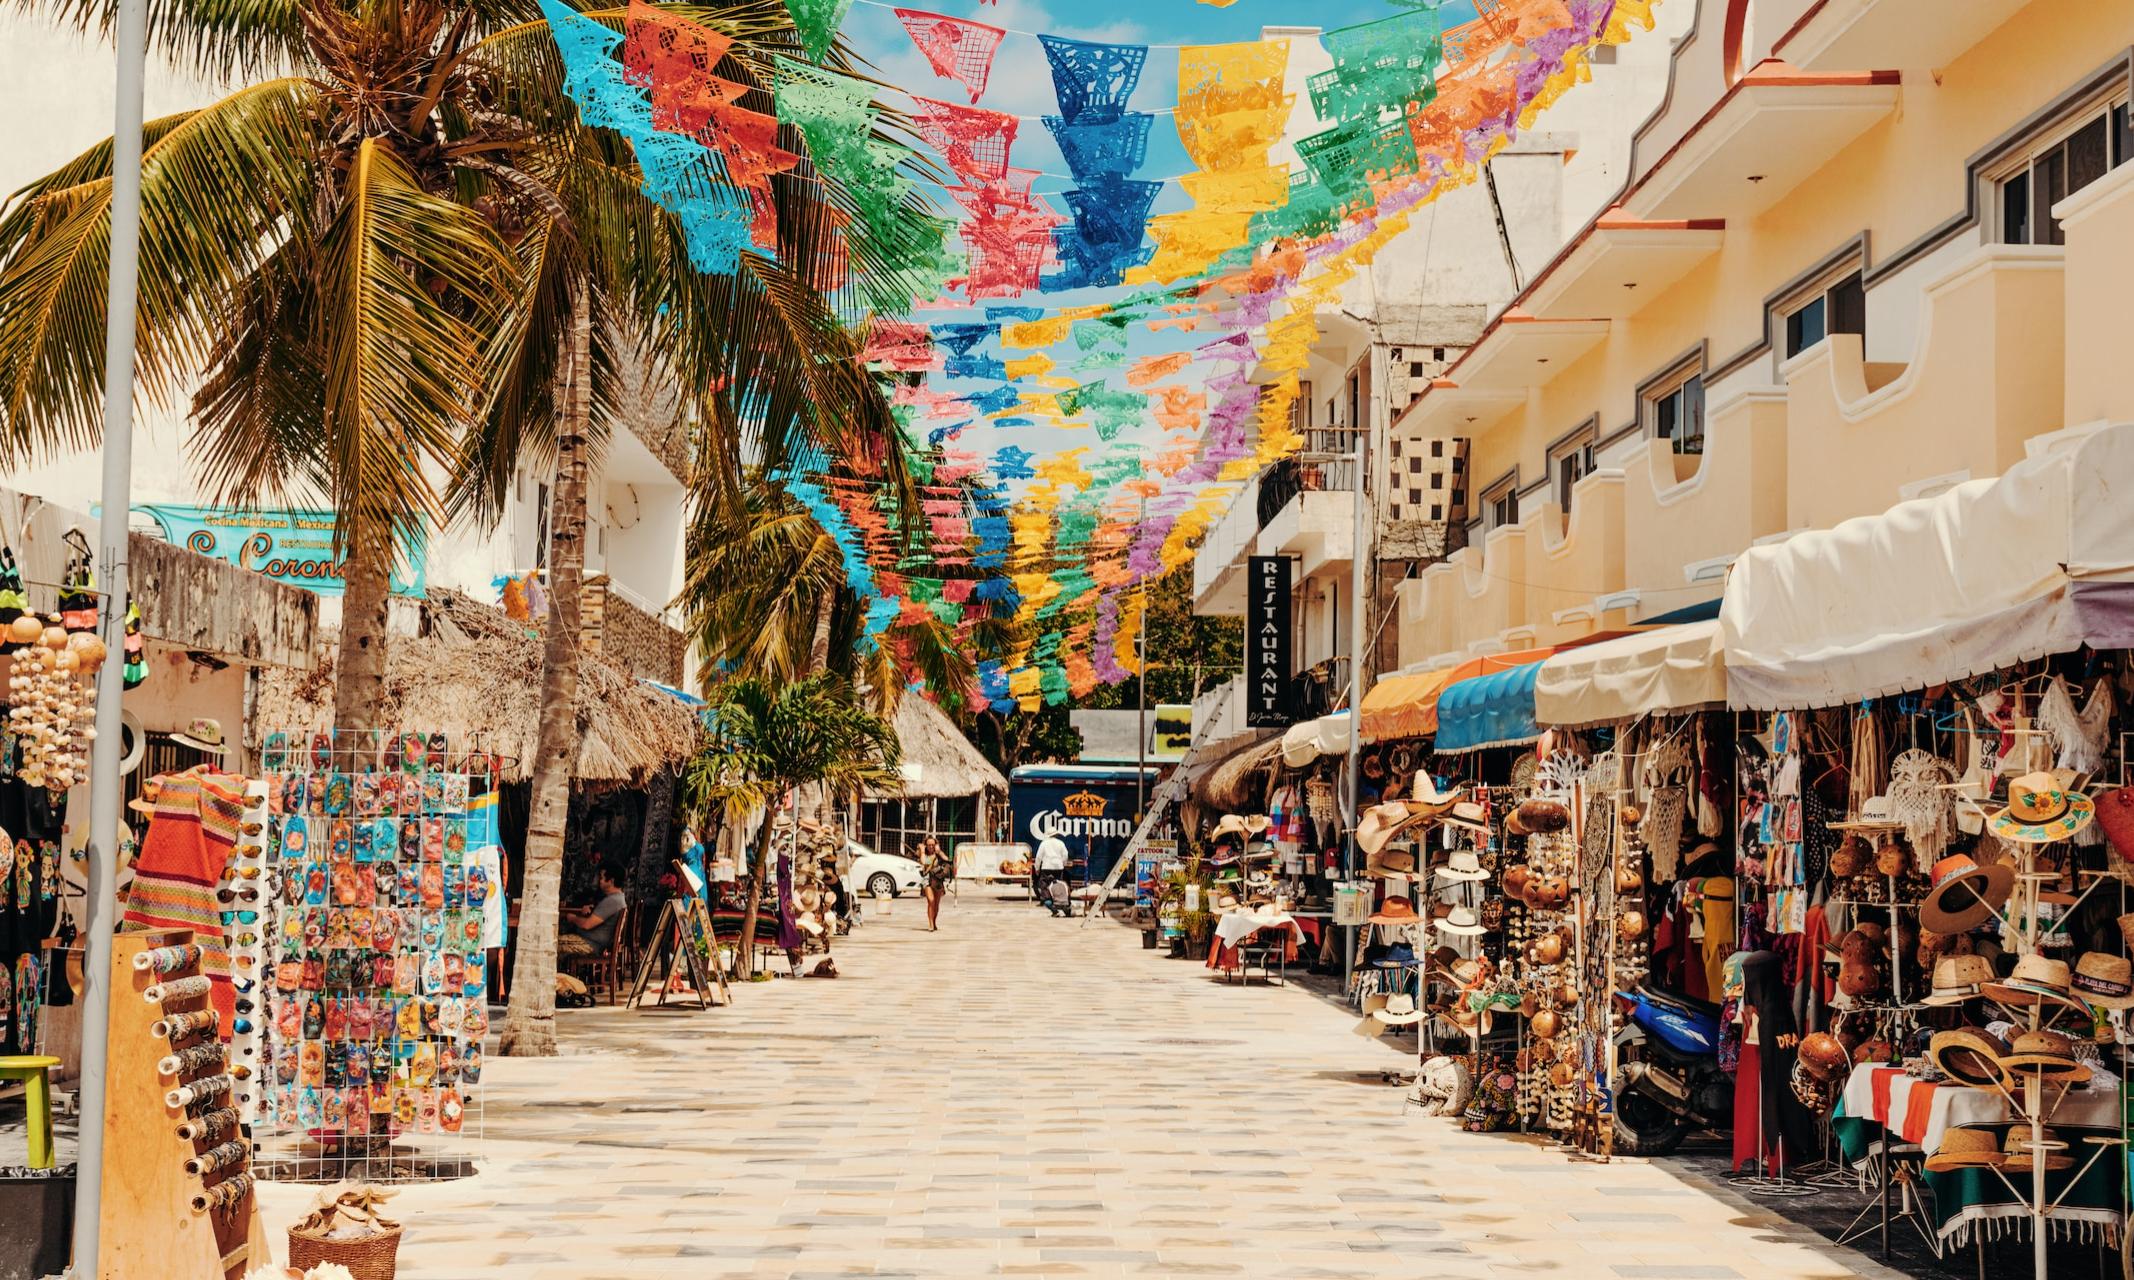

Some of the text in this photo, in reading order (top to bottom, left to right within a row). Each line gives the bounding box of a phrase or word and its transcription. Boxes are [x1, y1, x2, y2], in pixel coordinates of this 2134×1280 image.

[205, 515, 237, 526] Cocina
[240, 517, 287, 528] Mexicana
[1261, 562, 1278, 710] RESTAURANT
[1030, 809, 1131, 840] Corona
